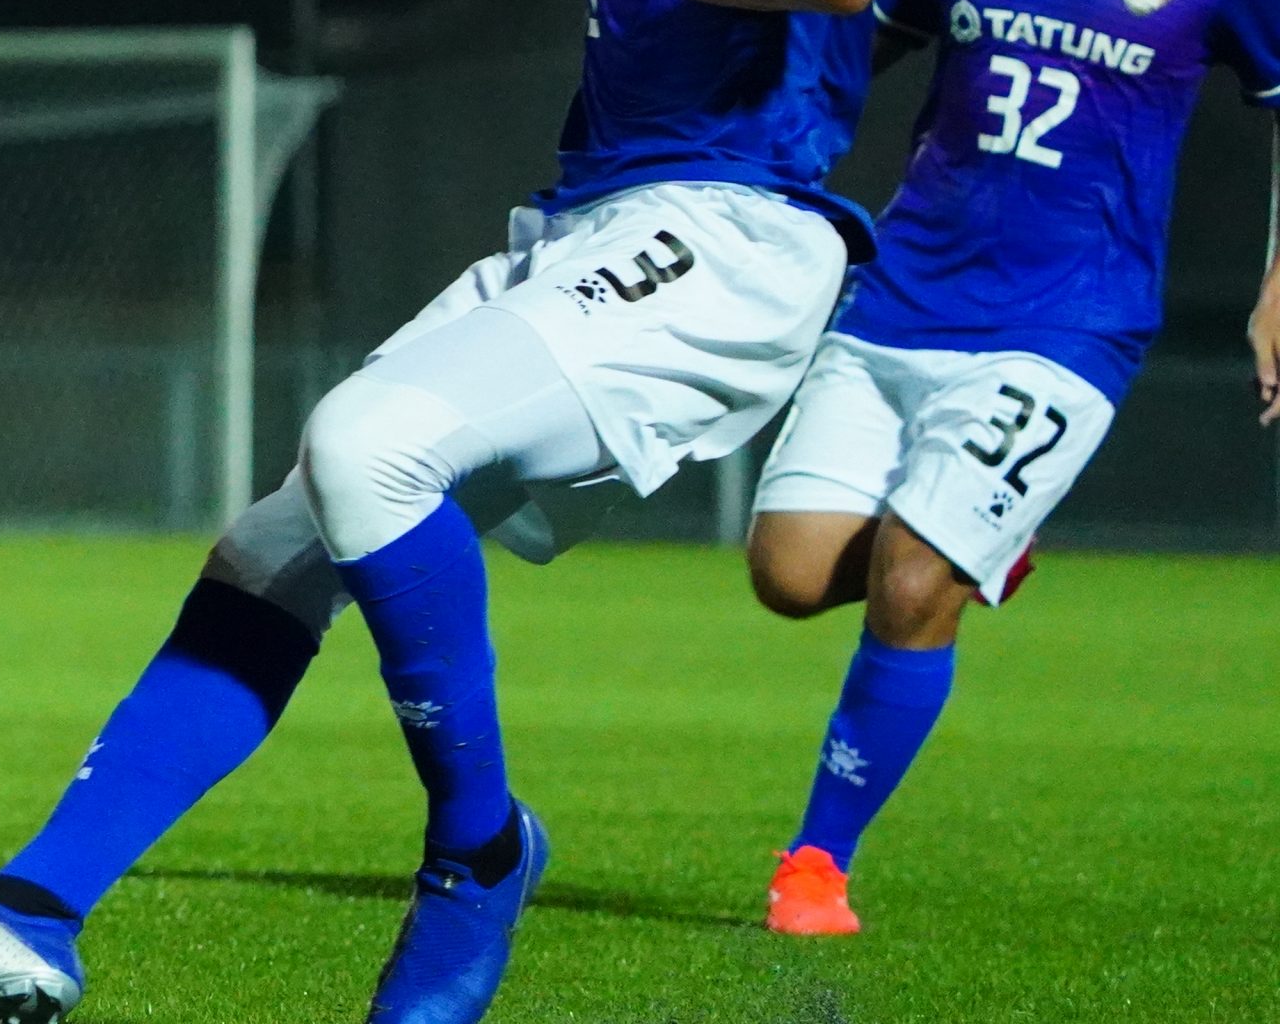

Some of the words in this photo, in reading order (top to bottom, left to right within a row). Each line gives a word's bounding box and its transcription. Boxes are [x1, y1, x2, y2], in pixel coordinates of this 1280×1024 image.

[983, 8, 1155, 75] TATUNG
[978, 54, 1081, 169] 32
[594, 230, 695, 303] 3
[961, 384, 1067, 497] 32
